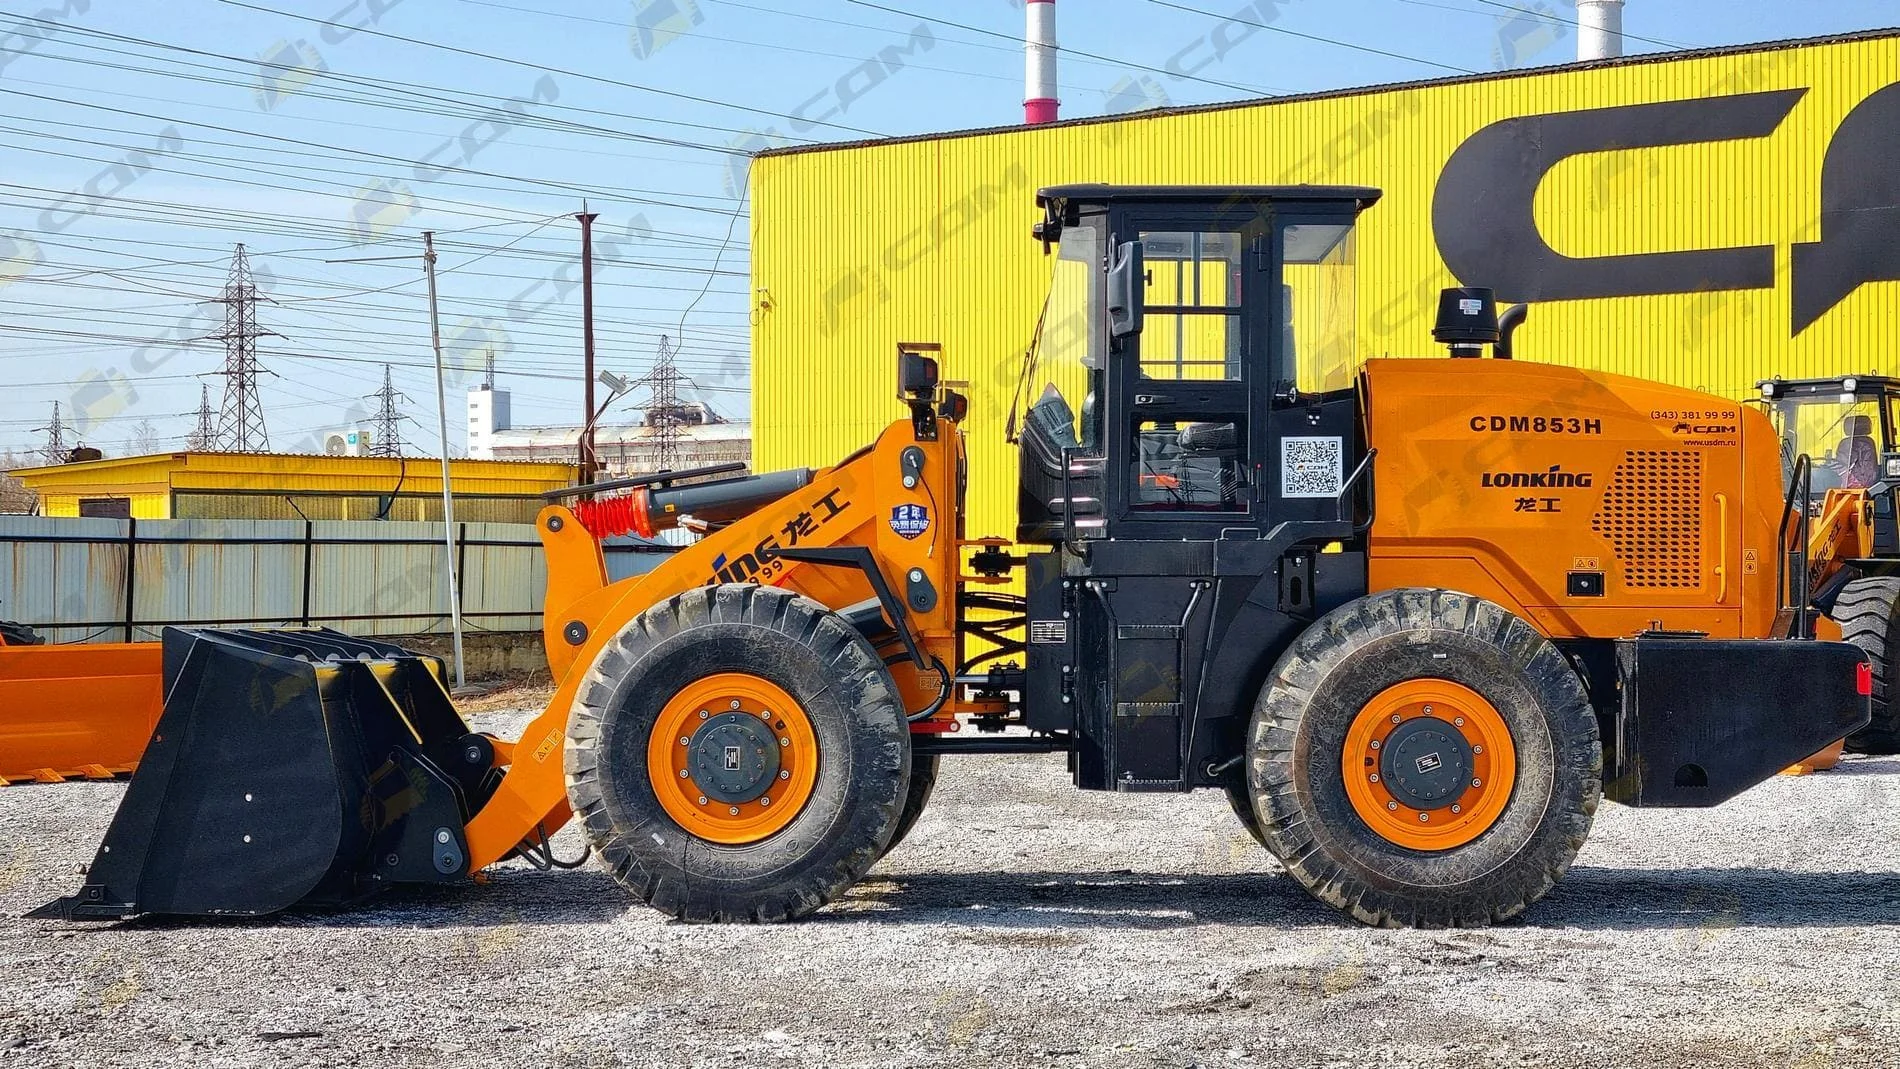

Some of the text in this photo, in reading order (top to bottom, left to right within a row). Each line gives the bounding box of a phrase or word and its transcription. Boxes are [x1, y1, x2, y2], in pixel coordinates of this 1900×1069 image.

[1650, 410, 1736, 420] (343) 381 99 99
[1469, 415, 1602, 435] CDM853H
[1683, 439, 1737, 447] www.usdm.ru
[1513, 497, 1562, 513] 龙工
[780, 486, 852, 546] 龙工
